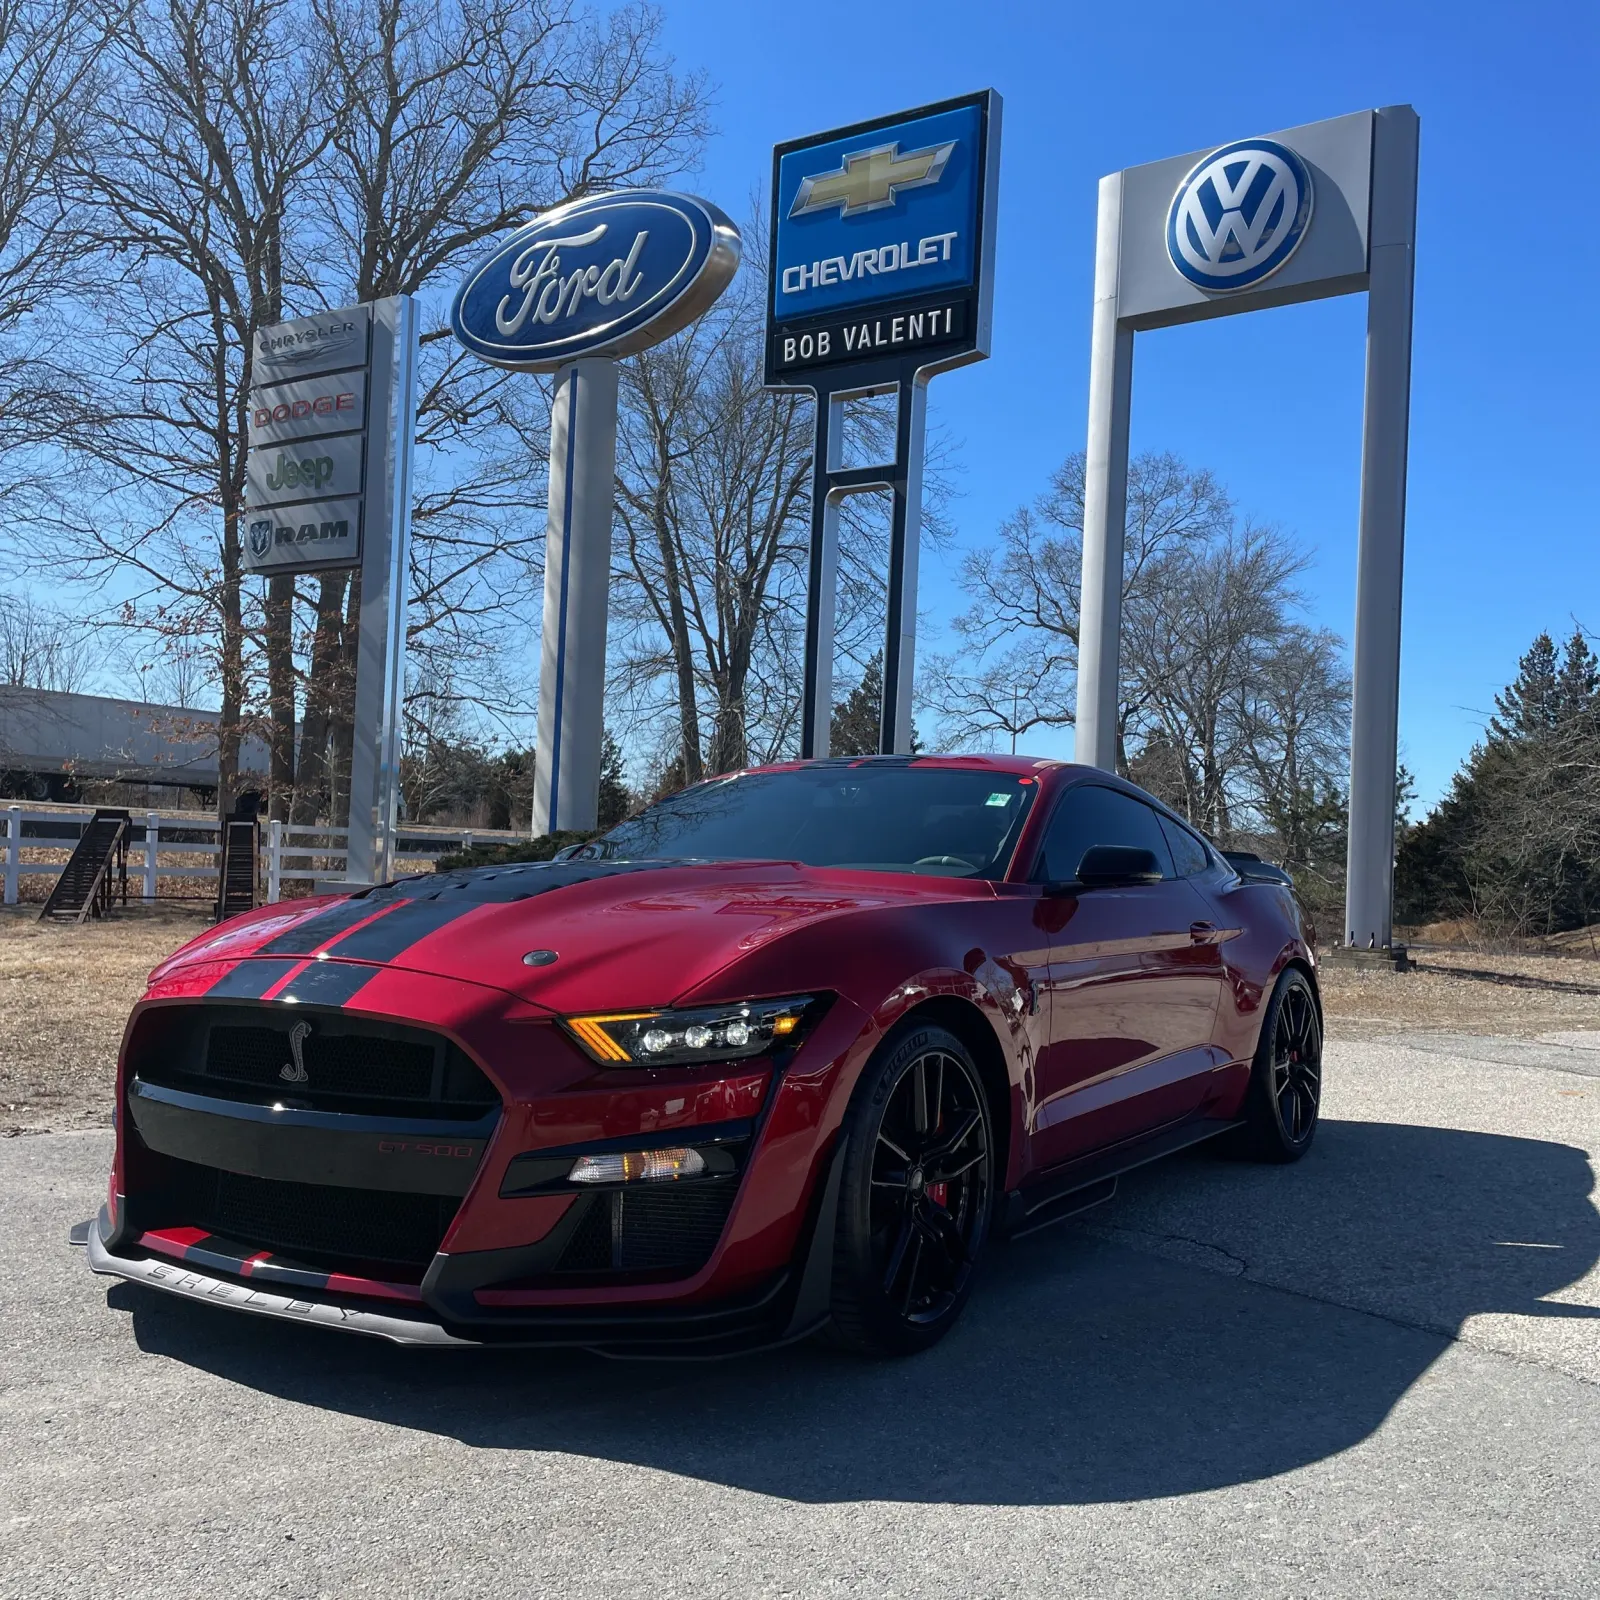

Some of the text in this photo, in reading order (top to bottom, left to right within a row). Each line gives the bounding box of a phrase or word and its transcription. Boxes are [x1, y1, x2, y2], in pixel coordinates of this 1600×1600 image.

[495, 223, 649, 336] Ford
[782, 231, 958, 294] CHEVROLET
[259, 322, 355, 353] CHRYSLER
[783, 308, 952, 363] BOB VALENTI
[254, 392, 355, 428] DODGE
[266, 453, 334, 491] Jeep
[274, 520, 348, 545] RAM
